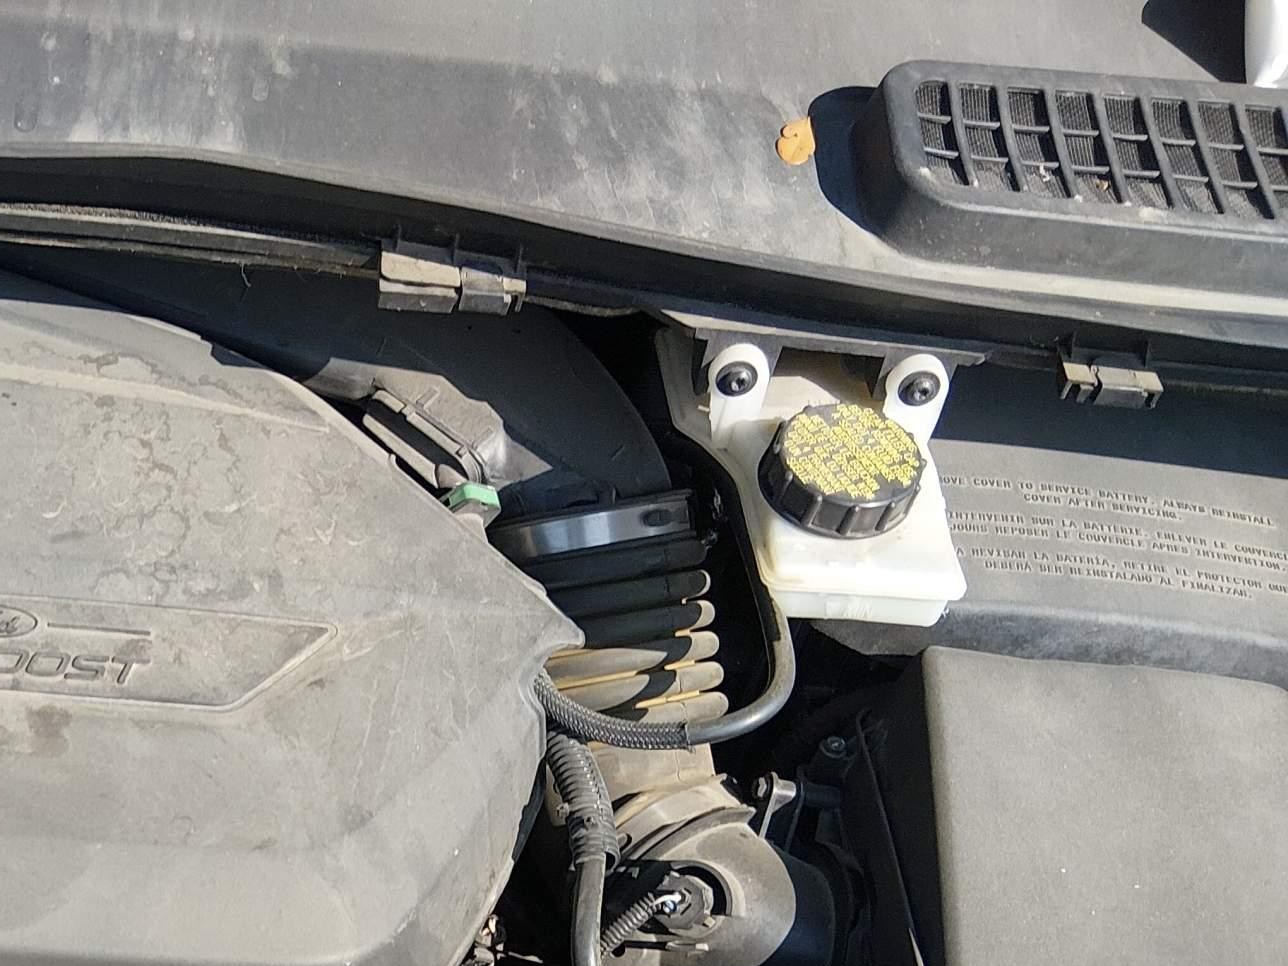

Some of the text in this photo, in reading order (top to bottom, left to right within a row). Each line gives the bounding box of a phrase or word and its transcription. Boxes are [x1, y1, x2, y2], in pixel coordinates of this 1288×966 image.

[972, 477, 1011, 489] COVER
[1019, 481, 1033, 490] TO
[1040, 482, 1091, 497] SERVICE
[1163, 499, 1206, 514] ALWAYS
[1212, 508, 1275, 527] REINSTALL
[1023, 493, 1062, 505] COVER
[1068, 498, 1106, 510] AFTER
[1056, 530, 1069, 540] LE
[1061, 519, 1078, 529] LA
[1214, 540, 1228, 550] LE
[1033, 551, 1049, 562] LA
[1175, 567, 1190, 577] EL
[1160, 576, 1173, 586] AL
